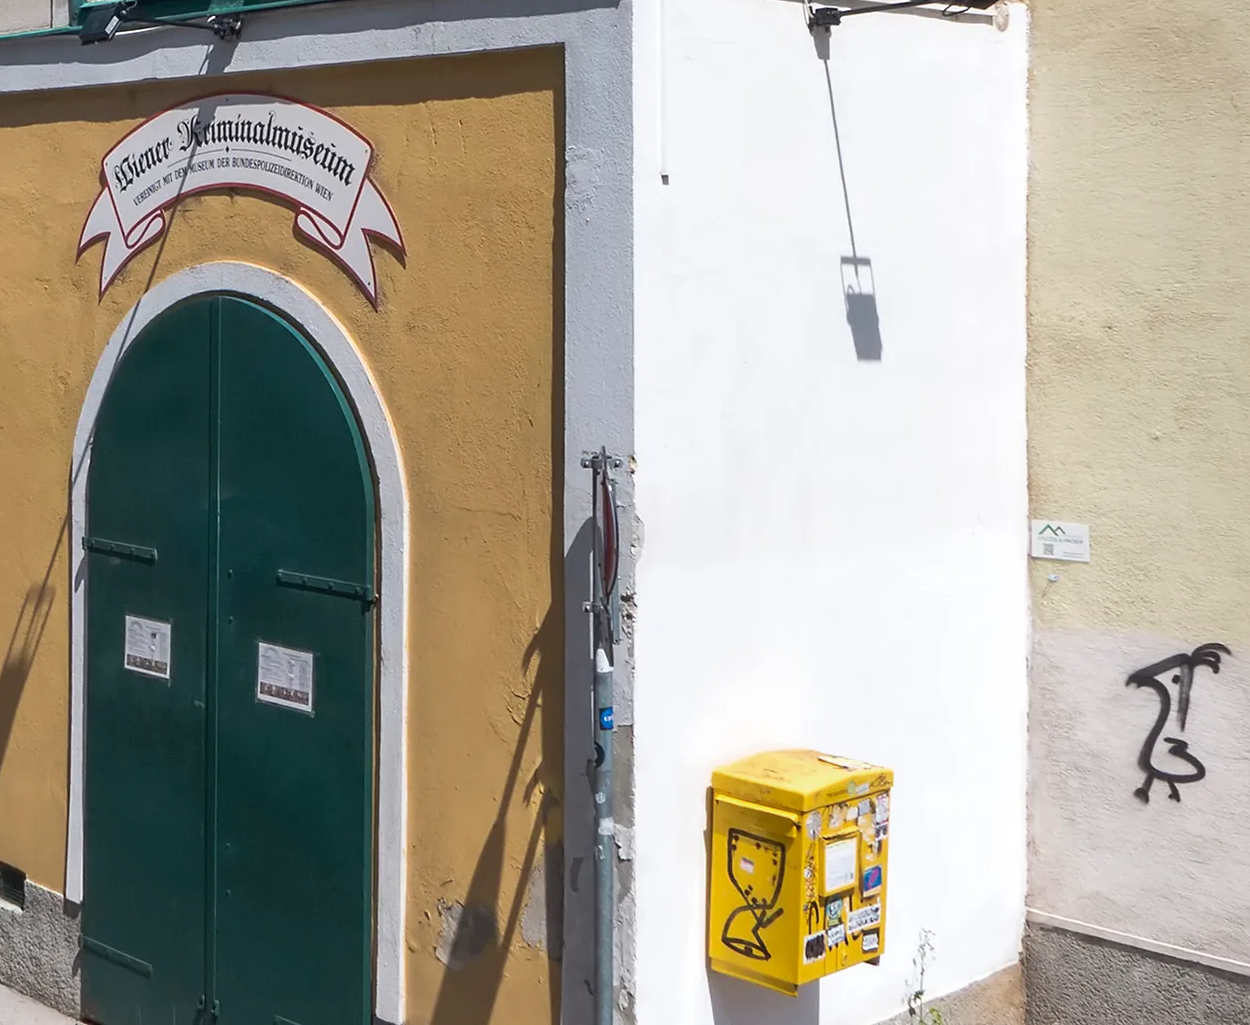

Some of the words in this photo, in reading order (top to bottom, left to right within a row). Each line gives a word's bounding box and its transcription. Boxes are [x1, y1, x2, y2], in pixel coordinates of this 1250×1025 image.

[113, 136, 173, 194] Wiener
[133, 179, 162, 206] VEREINIGT
[162, 170, 174, 187] MIT
[174, 166, 188, 181] DEM
[189, 157, 215, 175] MUSEUM
[216, 157, 231, 168] DER
[232, 157, 315, 191] BUNDESPOLIZEIDIREKTION
[315, 182, 334, 202] WIEN
